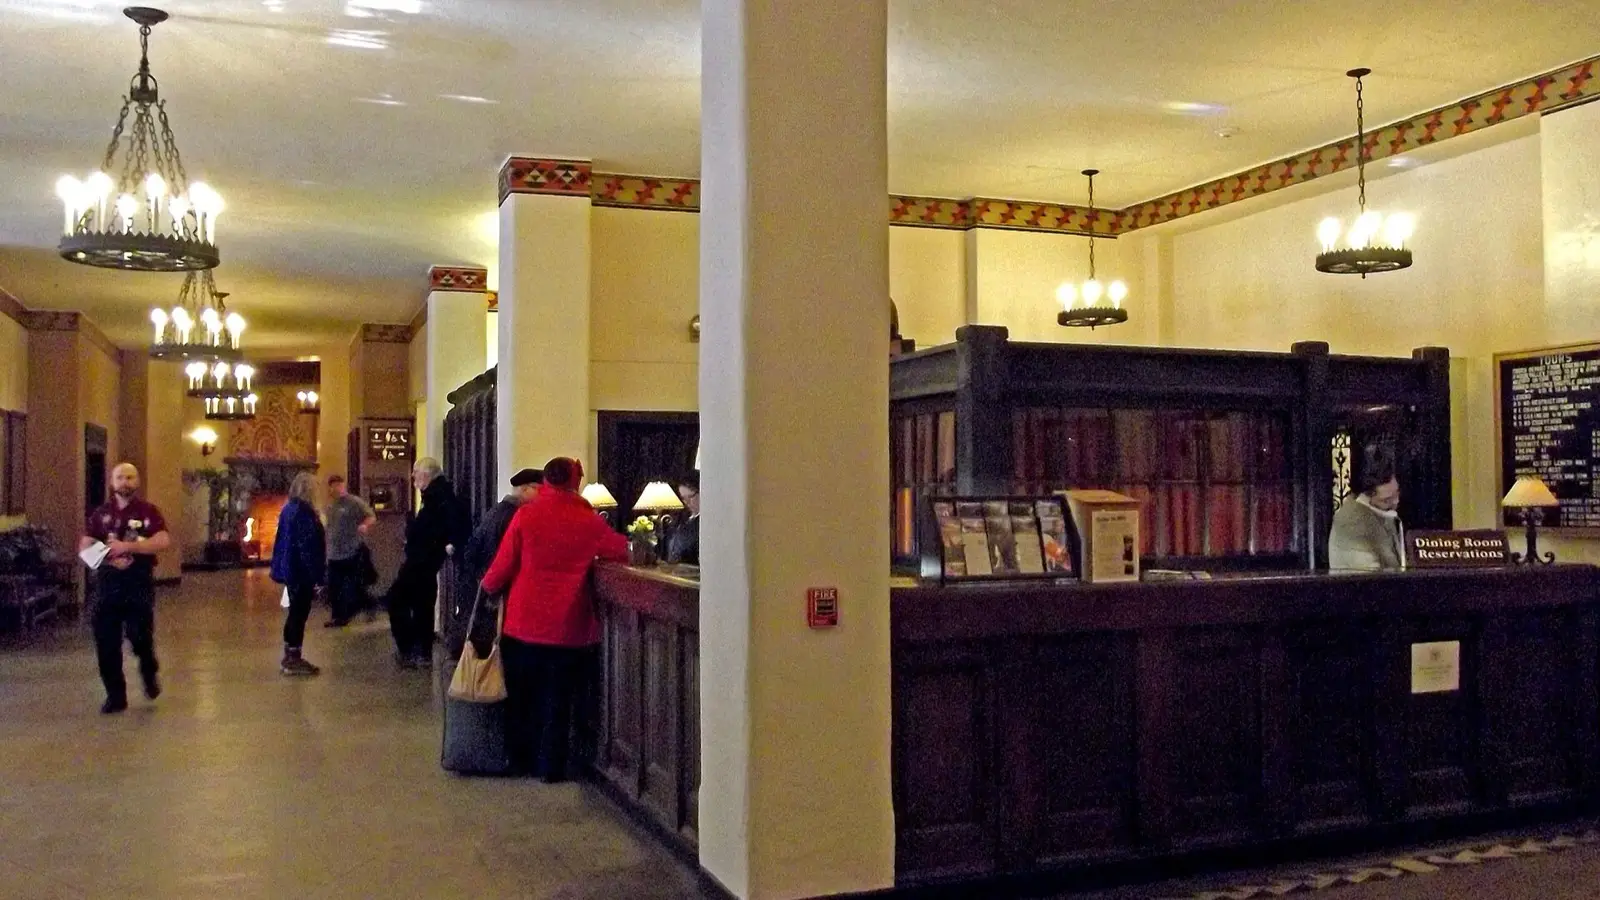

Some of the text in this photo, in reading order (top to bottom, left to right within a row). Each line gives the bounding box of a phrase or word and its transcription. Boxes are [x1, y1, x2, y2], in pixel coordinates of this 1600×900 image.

[1540, 355, 1573, 365] TOURS
[1415, 538, 1503, 549] Dining Room
[1419, 549, 1504, 559] Reservations
[814, 590, 835, 598] FIRE
